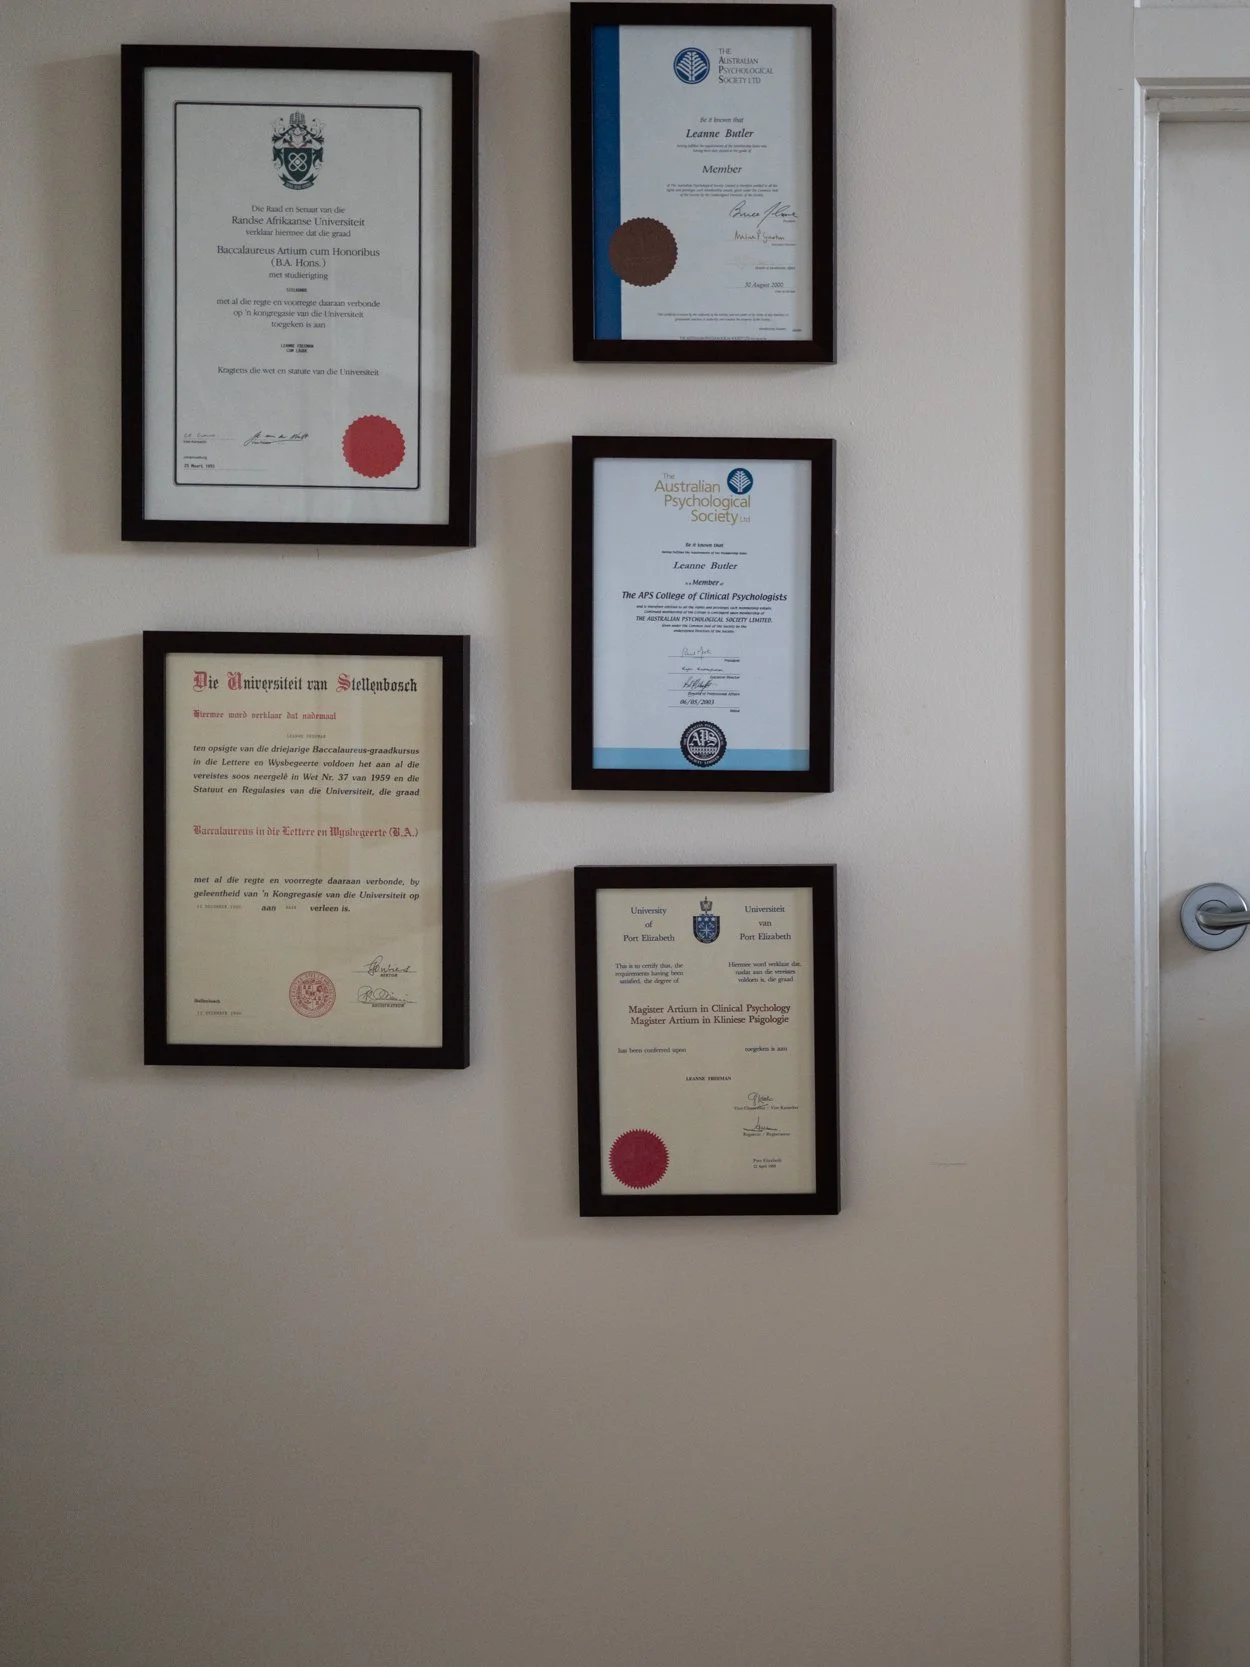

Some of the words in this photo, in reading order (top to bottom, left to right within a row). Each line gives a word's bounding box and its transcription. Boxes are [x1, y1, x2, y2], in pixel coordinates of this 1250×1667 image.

[719, 66, 773, 74] PSYCHOLOGICAL
[718, 75, 747, 84] SOCIETY
[748, 75, 761, 84] LTD
[687, 129, 719, 138] Leanne
[725, 128, 754, 138] Butler
[702, 165, 742, 174] Member
[232, 216, 264, 225] Randse
[266, 216, 312, 226] Afrikaanse
[314, 217, 365, 227] Universiteit
[218, 245, 274, 255] Baccalaureus
[278, 247, 307, 256] Artium
[333, 248, 380, 257] Honoribus
[270, 257, 294, 267] (B.A.
[295, 259, 326, 268] Hons.)
[218, 366, 248, 375] Kragtens
[655, 480, 720, 493] Australian
[664, 494, 750, 510] Psychological
[691, 509, 738, 526] Society
[622, 591, 636, 599] The
[656, 592, 685, 601] College
[688, 592, 698, 601] of
[699, 592, 730, 600] Clinical
[732, 593, 787, 602] Psychologists
[193, 671, 219, 692] Die
[227, 671, 303, 693] Universiteit
[306, 680, 328, 691] van
[336, 673, 418, 694] Stellenbosch
[208, 745, 237, 753] opsigte
[271, 745, 310, 755] driejarige
[313, 746, 419, 756] Baccalaureus-graadkursus
[222, 758, 250, 766] Lettere
[269, 759, 319, 768] Wysbegeerte
[323, 760, 354, 768] voldoen
[359, 760, 372, 768] het
[322, 773, 334, 781] Nr.
[338, 773, 349, 781] 37
[372, 774, 391, 782] 1959
[243, 786, 285, 795] Regulasies
[326, 787, 374, 795] Universiteit,
[396, 788, 419, 797] graad
[244, 877, 264, 885] regte
[285, 878, 323, 886] voorregte
[328, 877, 361, 885] daaraan
[366, 877, 405, 886] verbonde,
[410, 878, 420, 887] by
[194, 890, 240, 898] geleentheid
[272, 890, 322, 899] Kongregasie
[344, 891, 356, 899] die
[360, 891, 406, 899] Universiteit
[631, 907, 667, 916] University
[744, 905, 785, 913] Universiteit
[645, 920, 653, 928] of
[642, 934, 674, 942] Elizabeth
[741, 933, 754, 941] Port
[629, 1005, 663, 1015] Magister
[667, 1005, 697, 1013] Artium
[701, 1005, 708, 1013] in
[712, 1004, 742, 1013] Clinical
[747, 1004, 790, 1015] Psychology
[631, 1017, 665, 1027] Magister
[669, 1016, 699, 1024] Artium
[703, 1016, 710, 1024] in
[715, 1015, 745, 1024] Kliniese
[749, 1016, 789, 1026] Psigologie
